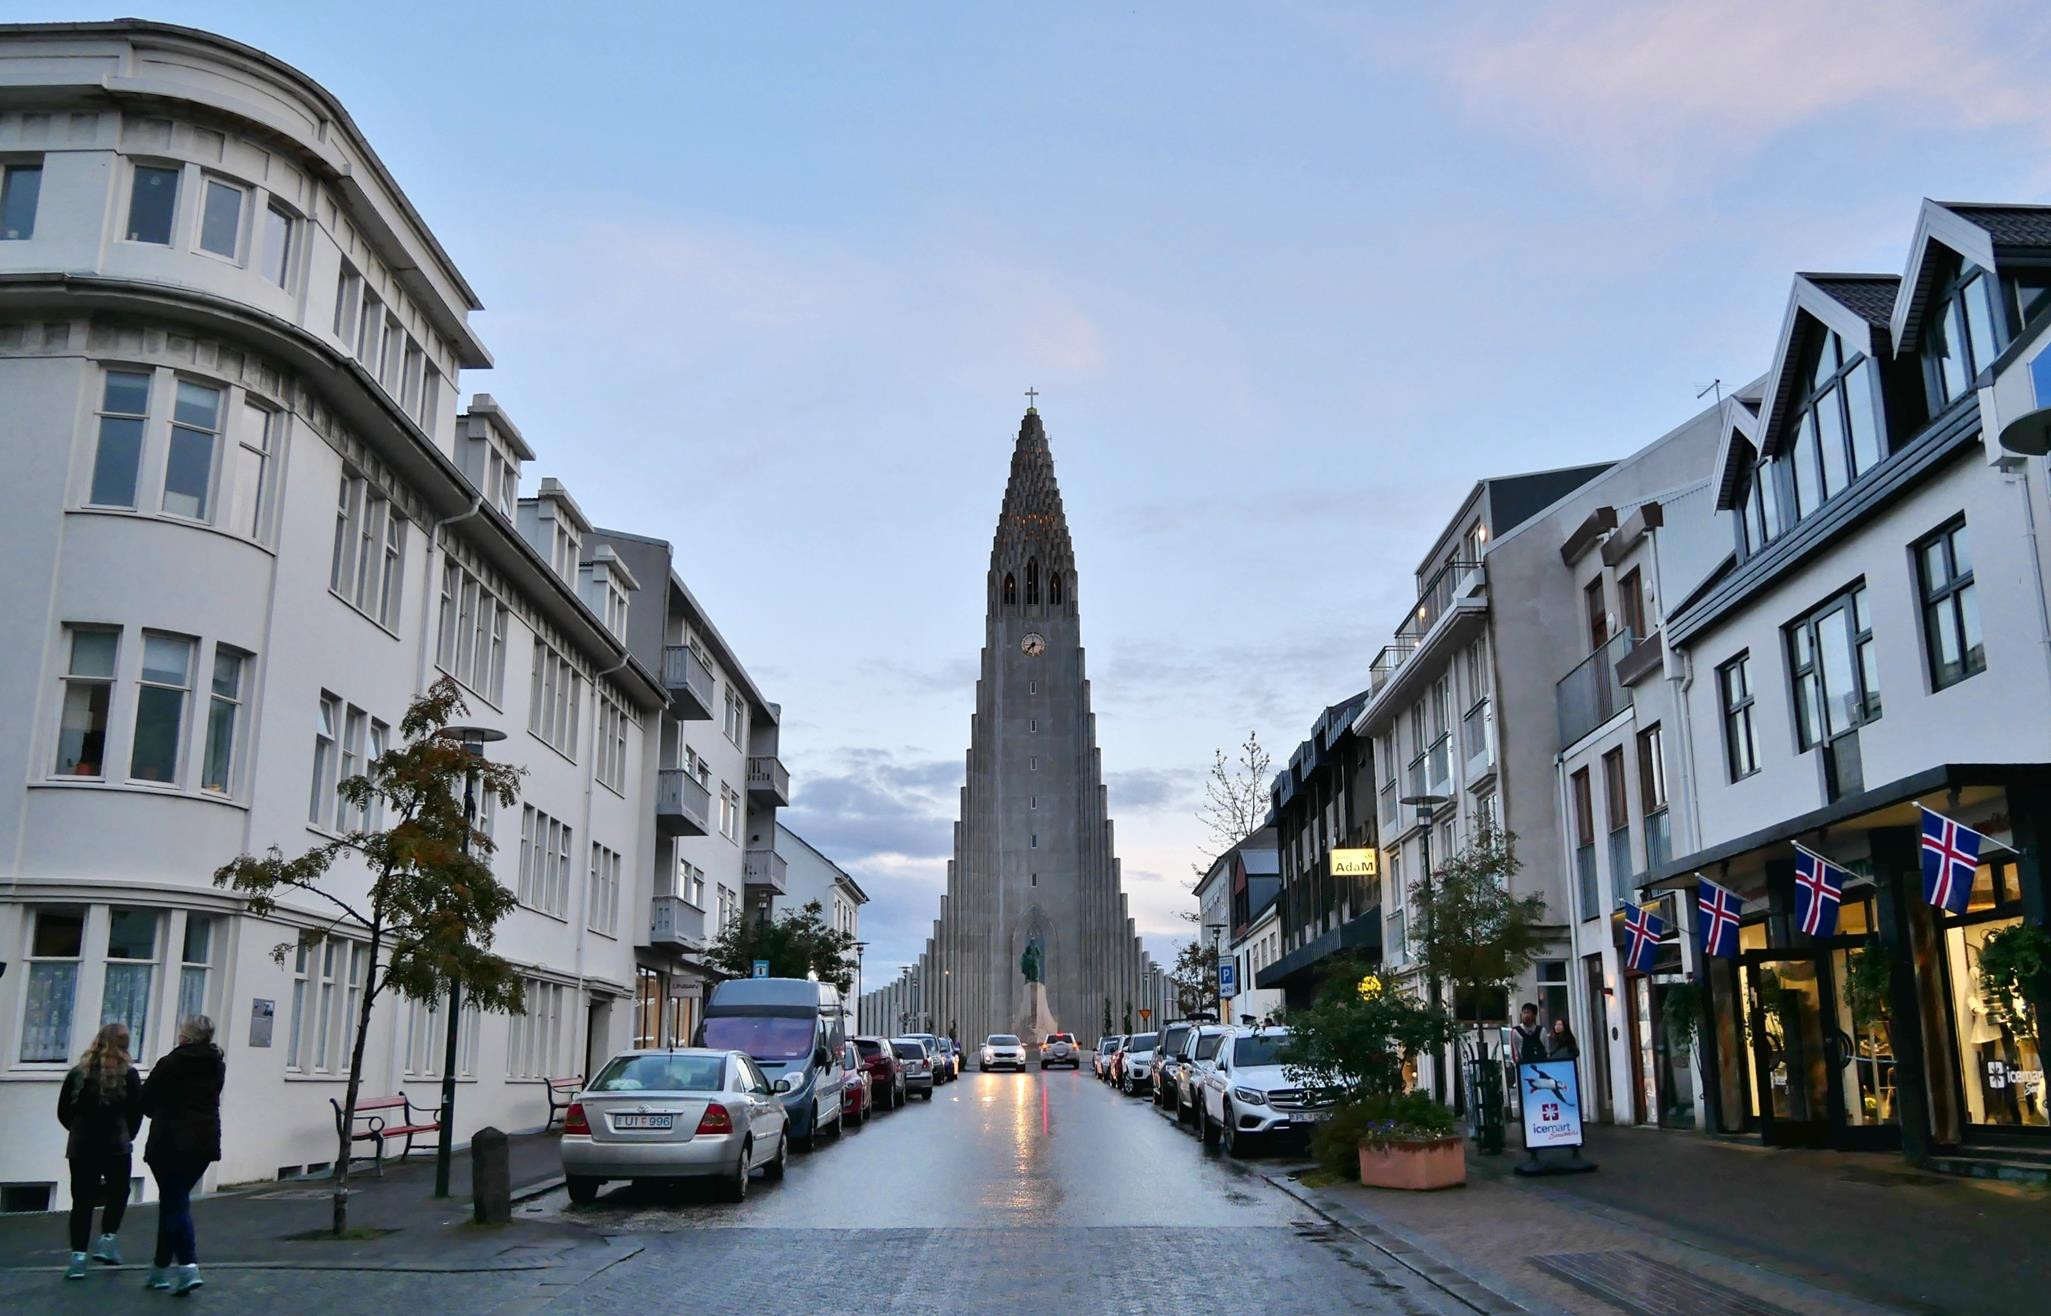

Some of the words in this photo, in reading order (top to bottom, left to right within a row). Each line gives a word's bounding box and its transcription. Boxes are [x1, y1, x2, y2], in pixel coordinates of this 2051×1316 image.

[1335, 861, 1374, 872] AdaM
[1223, 968, 1230, 981] P
[649, 1116, 670, 1126] 996
[1532, 1122, 1571, 1134] icemart
